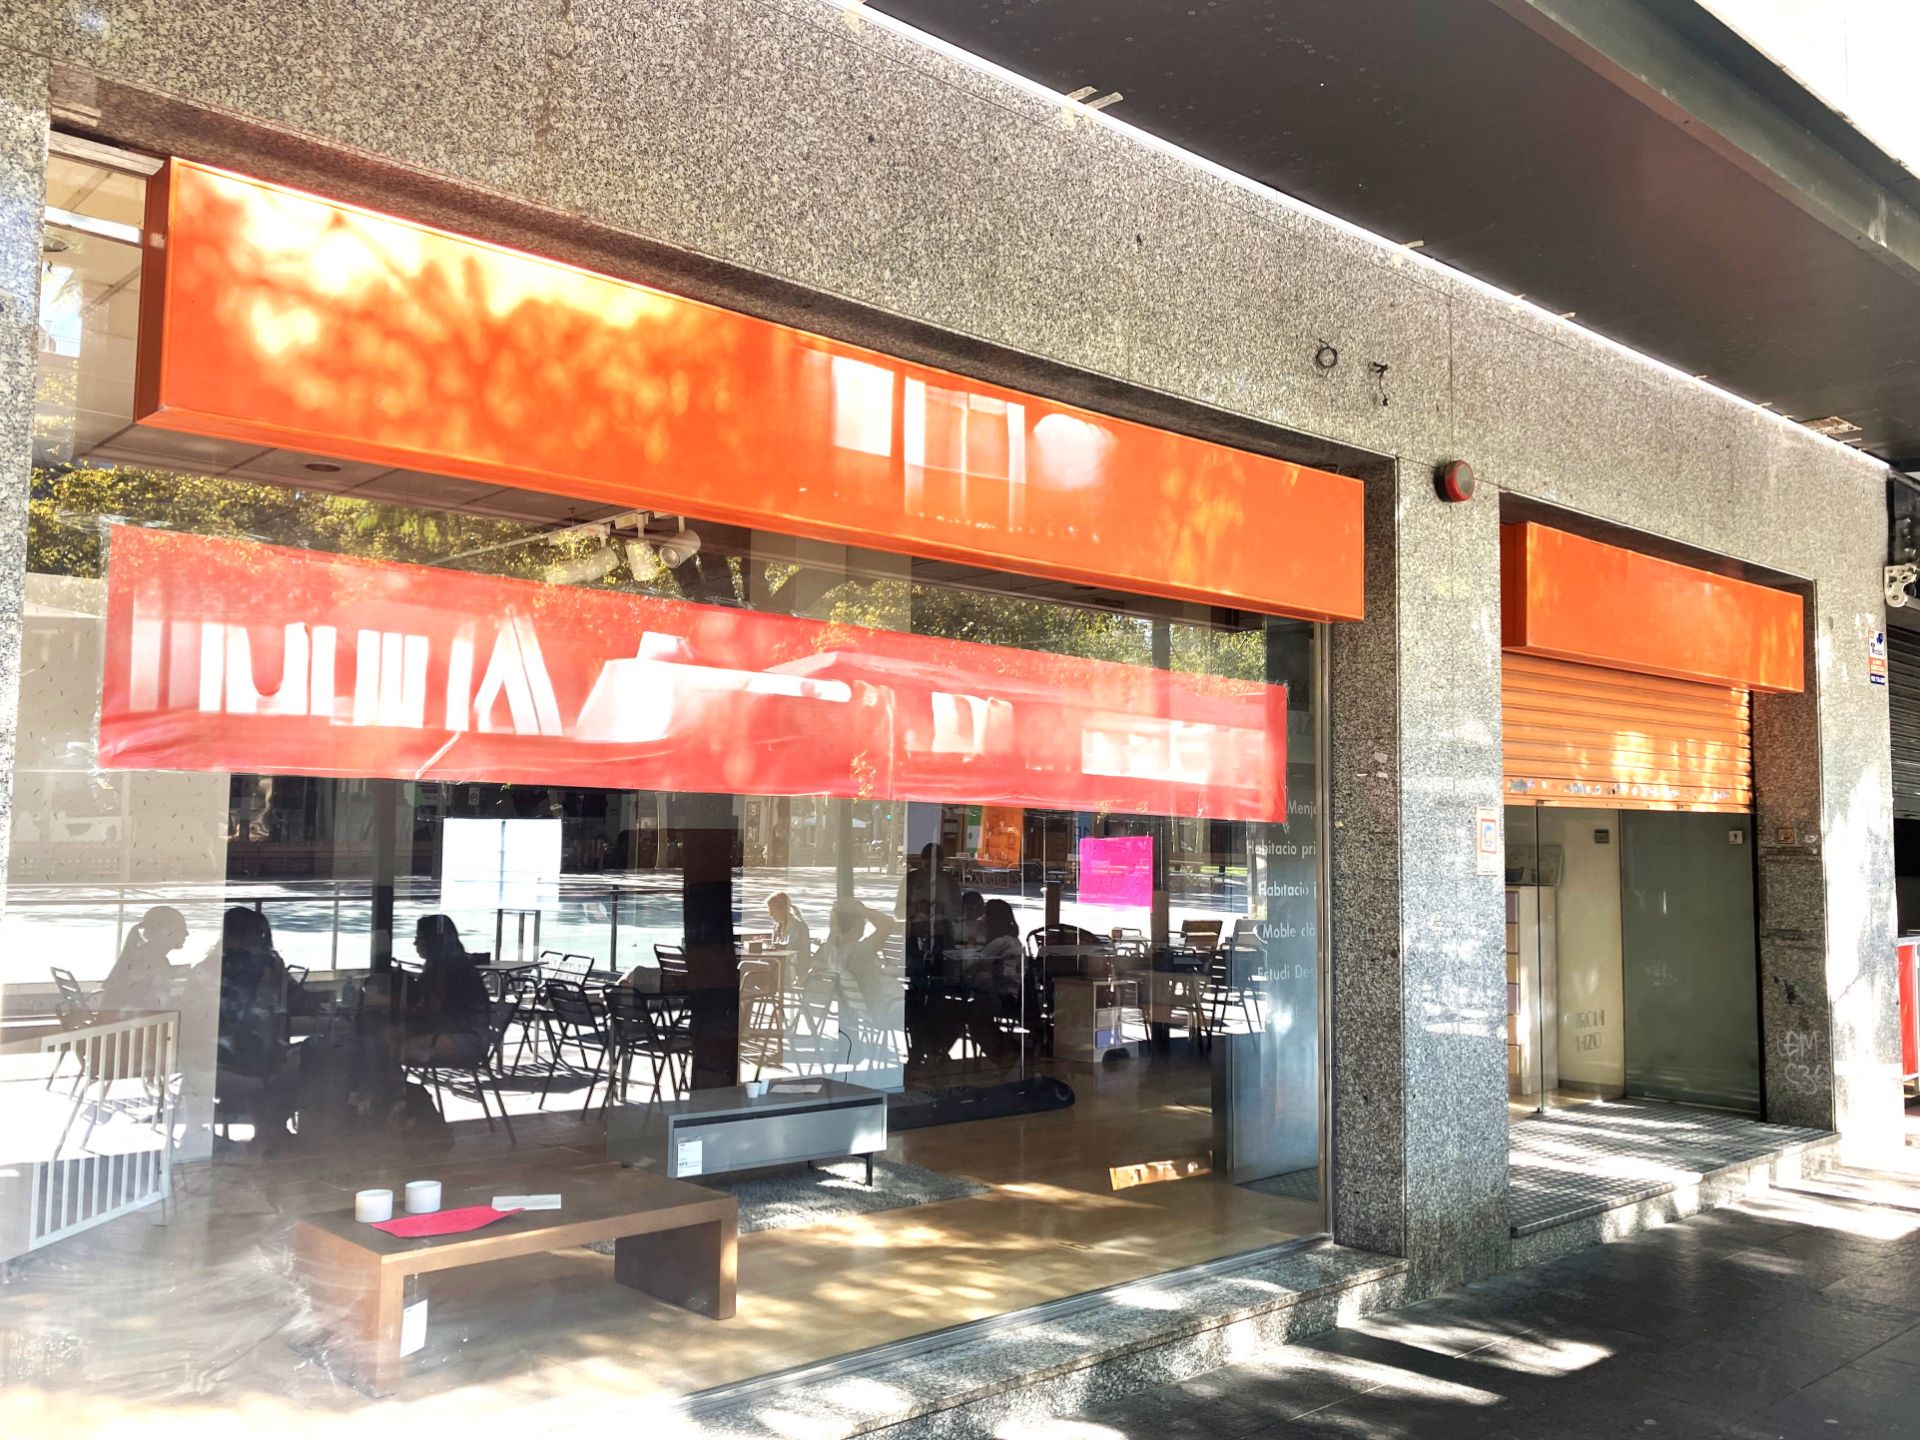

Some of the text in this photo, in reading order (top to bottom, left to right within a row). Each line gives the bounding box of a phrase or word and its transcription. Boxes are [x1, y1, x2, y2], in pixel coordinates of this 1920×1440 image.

[1301, 840, 1316, 860] pri
[1262, 922, 1297, 939] Moble
[1257, 963, 1290, 981] Estudi
